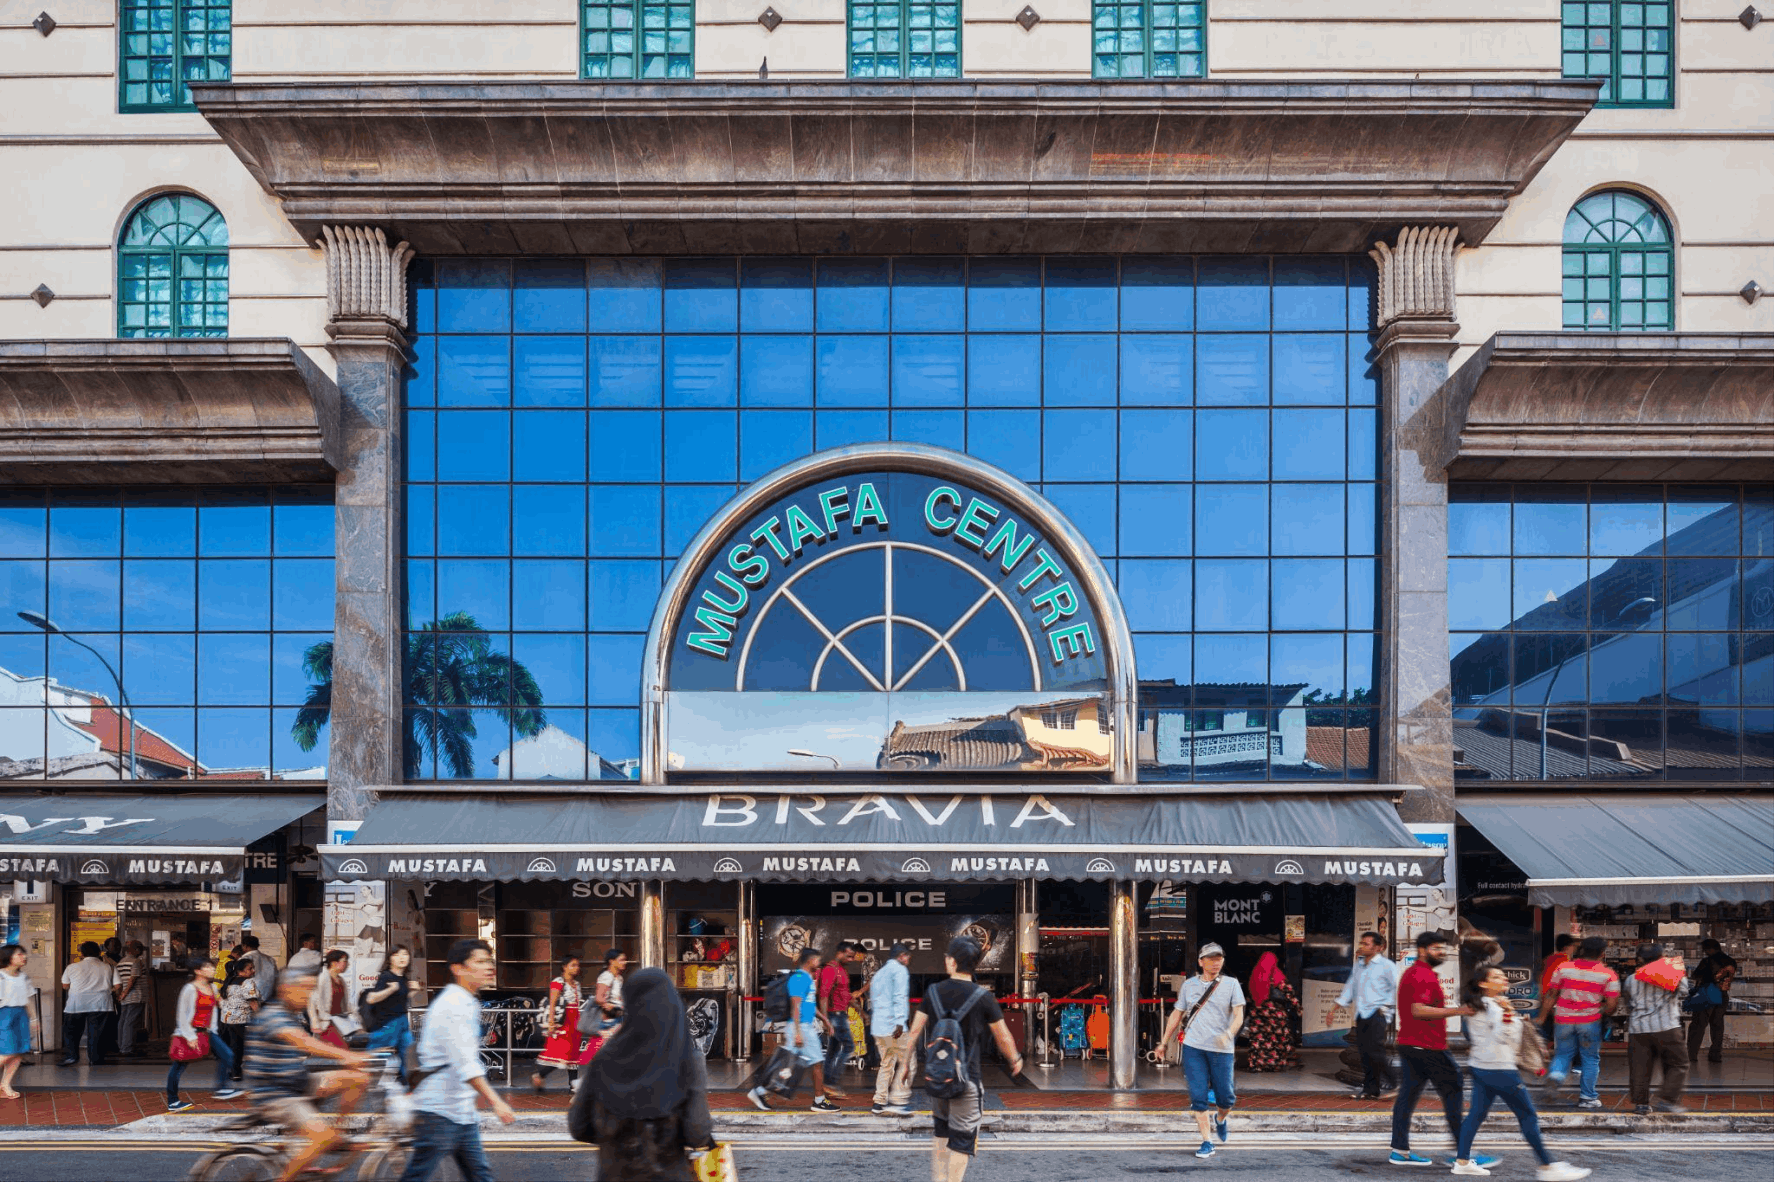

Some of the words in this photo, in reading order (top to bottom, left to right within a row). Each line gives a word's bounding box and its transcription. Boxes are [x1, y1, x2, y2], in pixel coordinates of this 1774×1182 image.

[686, 482, 889, 661] MUSTAFA
[923, 485, 1097, 665] CENTRE
[702, 794, 1075, 829] BRAVIA
[128, 859, 224, 873] MUSTAFA
[388, 858, 487, 873] MUSTAFA
[576, 857, 676, 872] MUSTAFA
[762, 857, 861, 872] MUSTAFA
[950, 857, 1050, 872] MUSTAFA
[1134, 858, 1233, 874] MUSTAFA
[1324, 861, 1424, 877] MUSTAFA
[831, 891, 946, 907] POLICE
[1214, 899, 1260, 911] MONT
[1214, 911, 1260, 924] BLANC
[1506, 970, 1527, 980] hick
